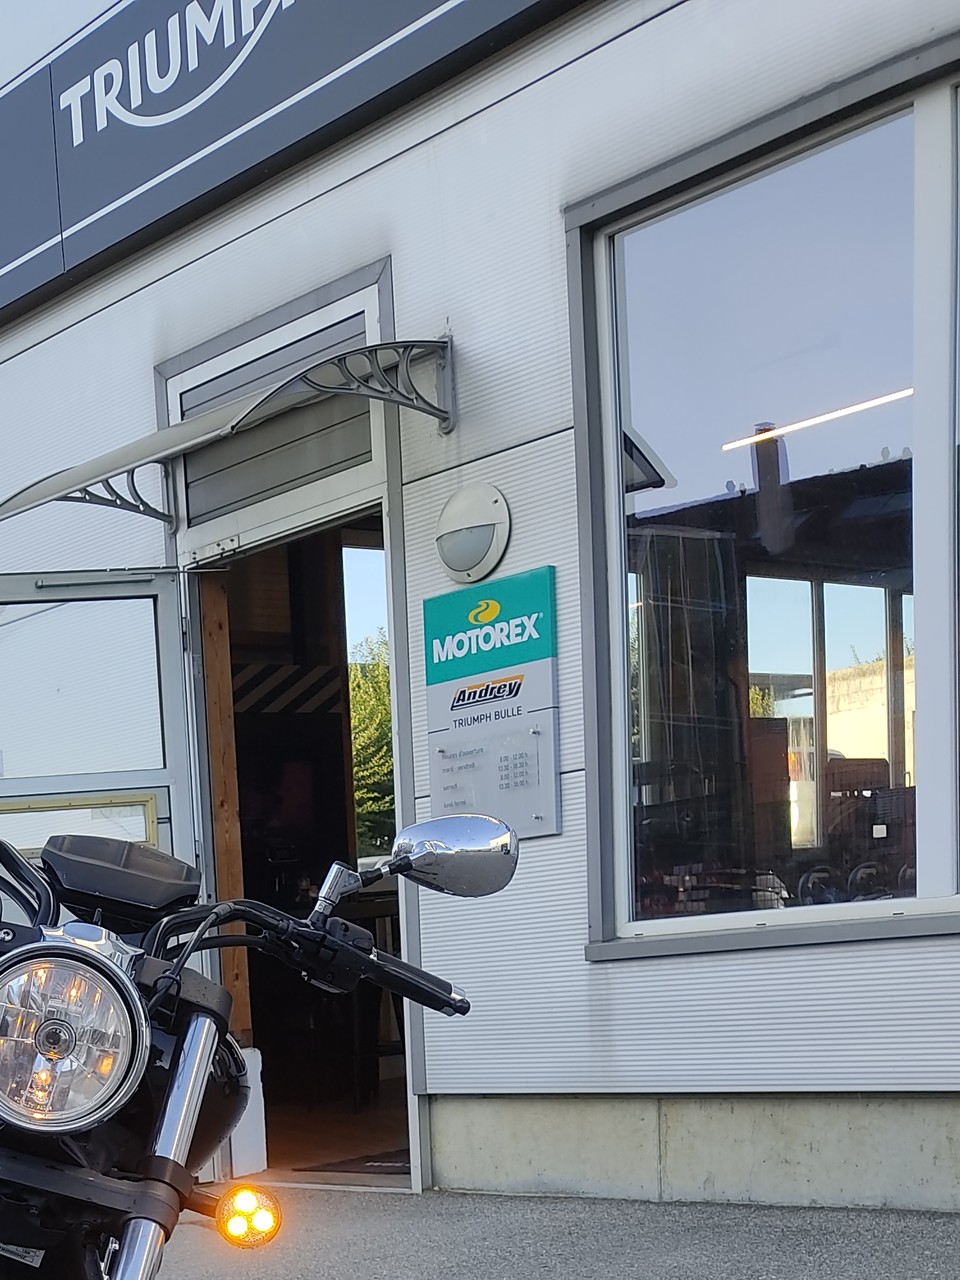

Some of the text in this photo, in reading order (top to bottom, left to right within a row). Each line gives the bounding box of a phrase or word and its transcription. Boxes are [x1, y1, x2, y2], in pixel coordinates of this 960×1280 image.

[432, 612, 540, 664] MOTOREX
[455, 680, 519, 704] Andrey
[453, 706, 523, 729] TRIUMPH BULLE
